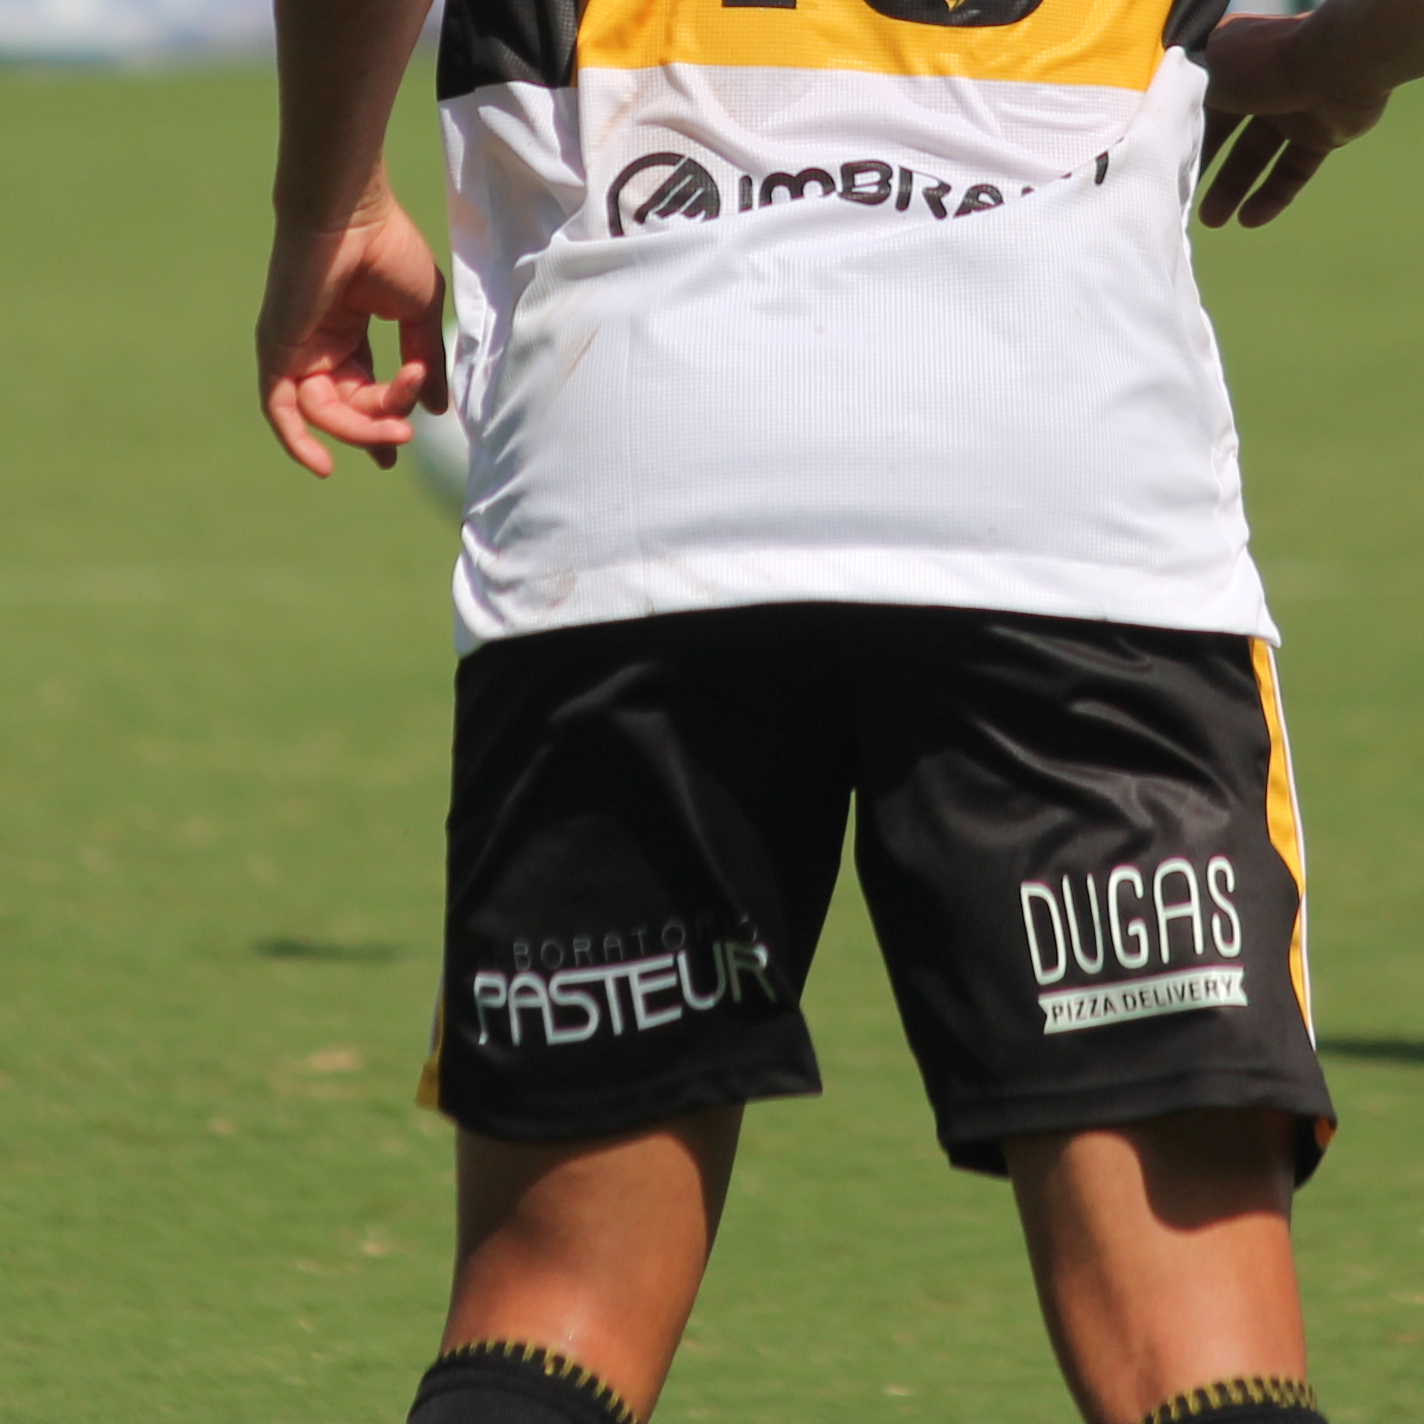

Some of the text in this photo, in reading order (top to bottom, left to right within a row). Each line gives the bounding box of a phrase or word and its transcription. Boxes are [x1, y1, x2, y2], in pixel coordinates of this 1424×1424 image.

[1020, 854, 1243, 986] DUGAS
[473, 940, 778, 1046] PASTEUR
[1051, 978, 1233, 1026] PIZZA DELIVERY
